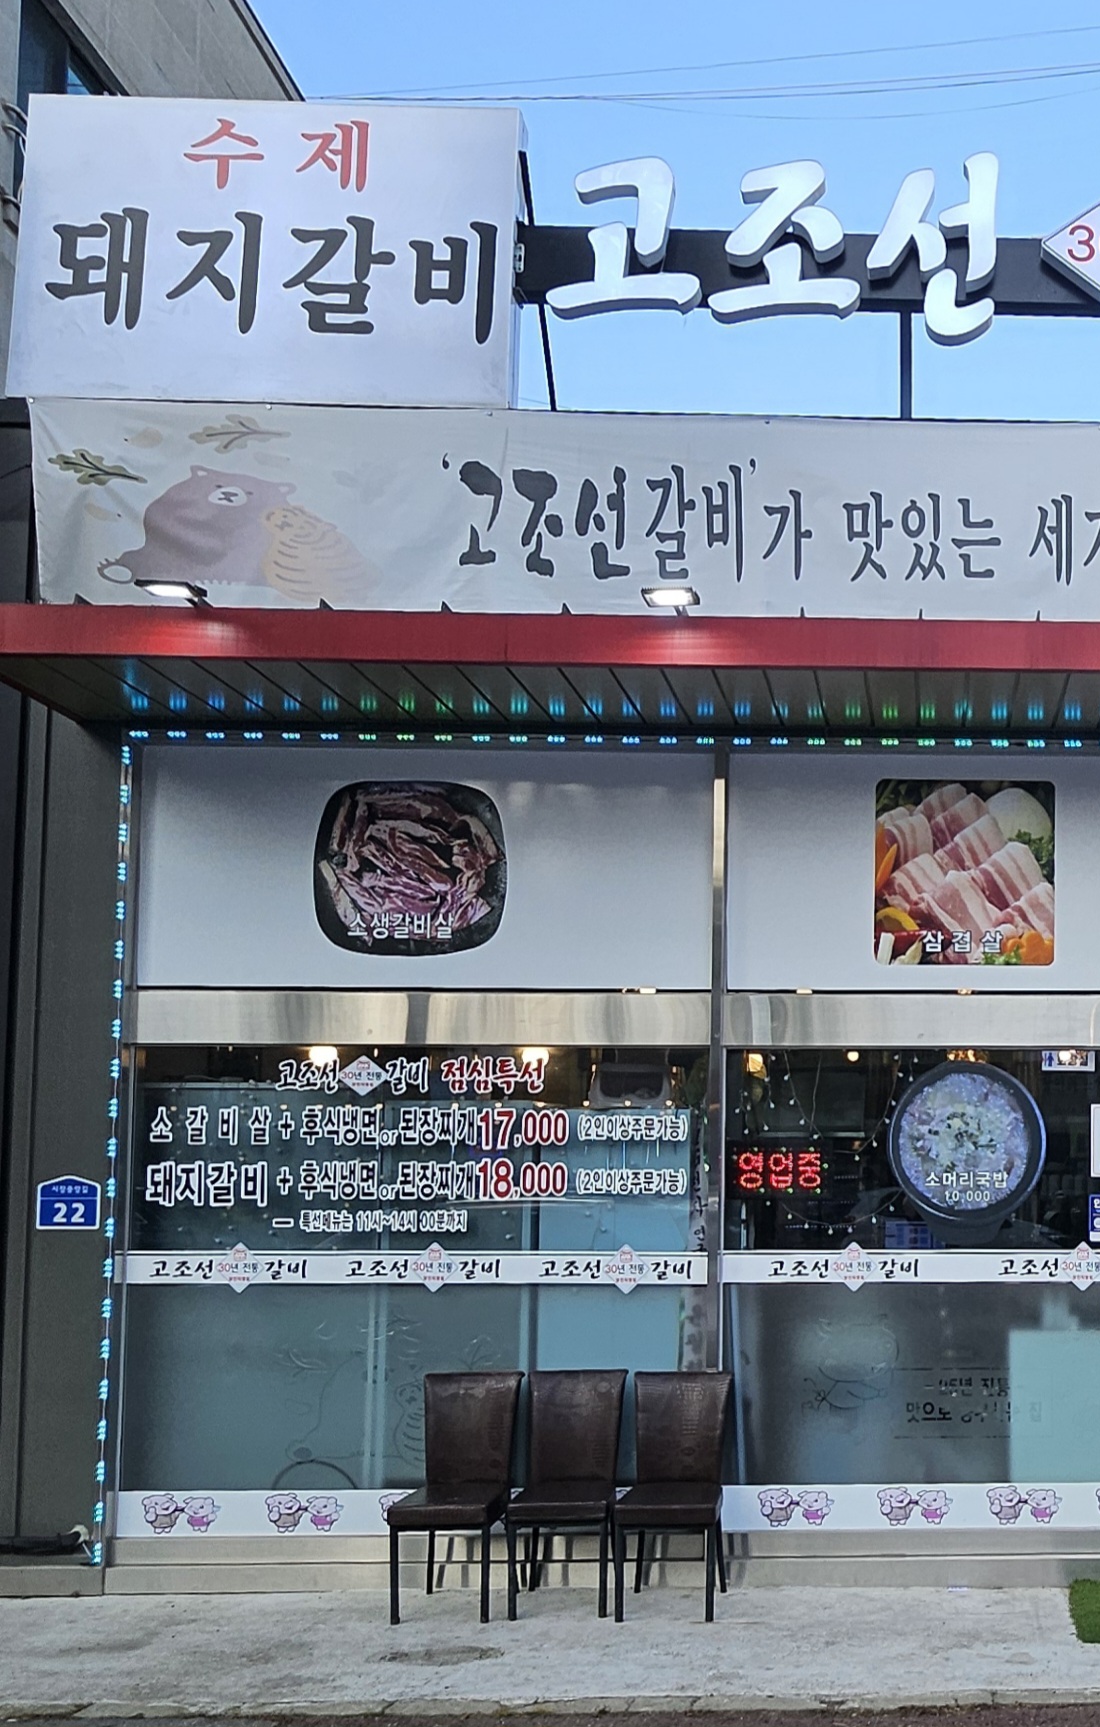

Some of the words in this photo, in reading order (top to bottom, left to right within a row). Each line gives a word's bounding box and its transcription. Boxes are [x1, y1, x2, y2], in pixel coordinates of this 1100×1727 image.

[183, 118, 370, 192] 수제
[546, 151, 998, 346] 고조선
[45, 207, 498, 344] 돼지갈비
[842, 491, 1001, 582] 맛있는
[347, 912, 454, 939] 소생갈비살
[923, 931, 1003, 953] 삼겹살
[276, 1058, 339, 1093] 고조선
[386, 1057, 429, 1094] 갈비
[441, 1056, 545, 1094] 점심특선
[577, 1113, 690, 1141] (2인이상주문가능)
[739, 1152, 820, 1188] 영업중
[925, 1171, 1009, 1188] 소머리국밥
[146, 1160, 268, 1206] 돼지갈비
[575, 1166, 687, 1196] (2인이상주문가능)
[53, 1202, 85, 1223] 22
[300, 1210, 352, 1232] 특선메뉴는
[150, 1259, 214, 1280] 고조선
[264, 1259, 307, 1280] 갈비
[346, 1259, 409, 1280] 고조선
[459, 1259, 501, 1280] 갈비
[539, 1259, 602, 1280] 고조선
[650, 1259, 692, 1280] 갈비
[768, 1259, 829, 1278] 고조선
[878, 1258, 919, 1279] 갈비
[998, 1257, 1059, 1278] 고조선
